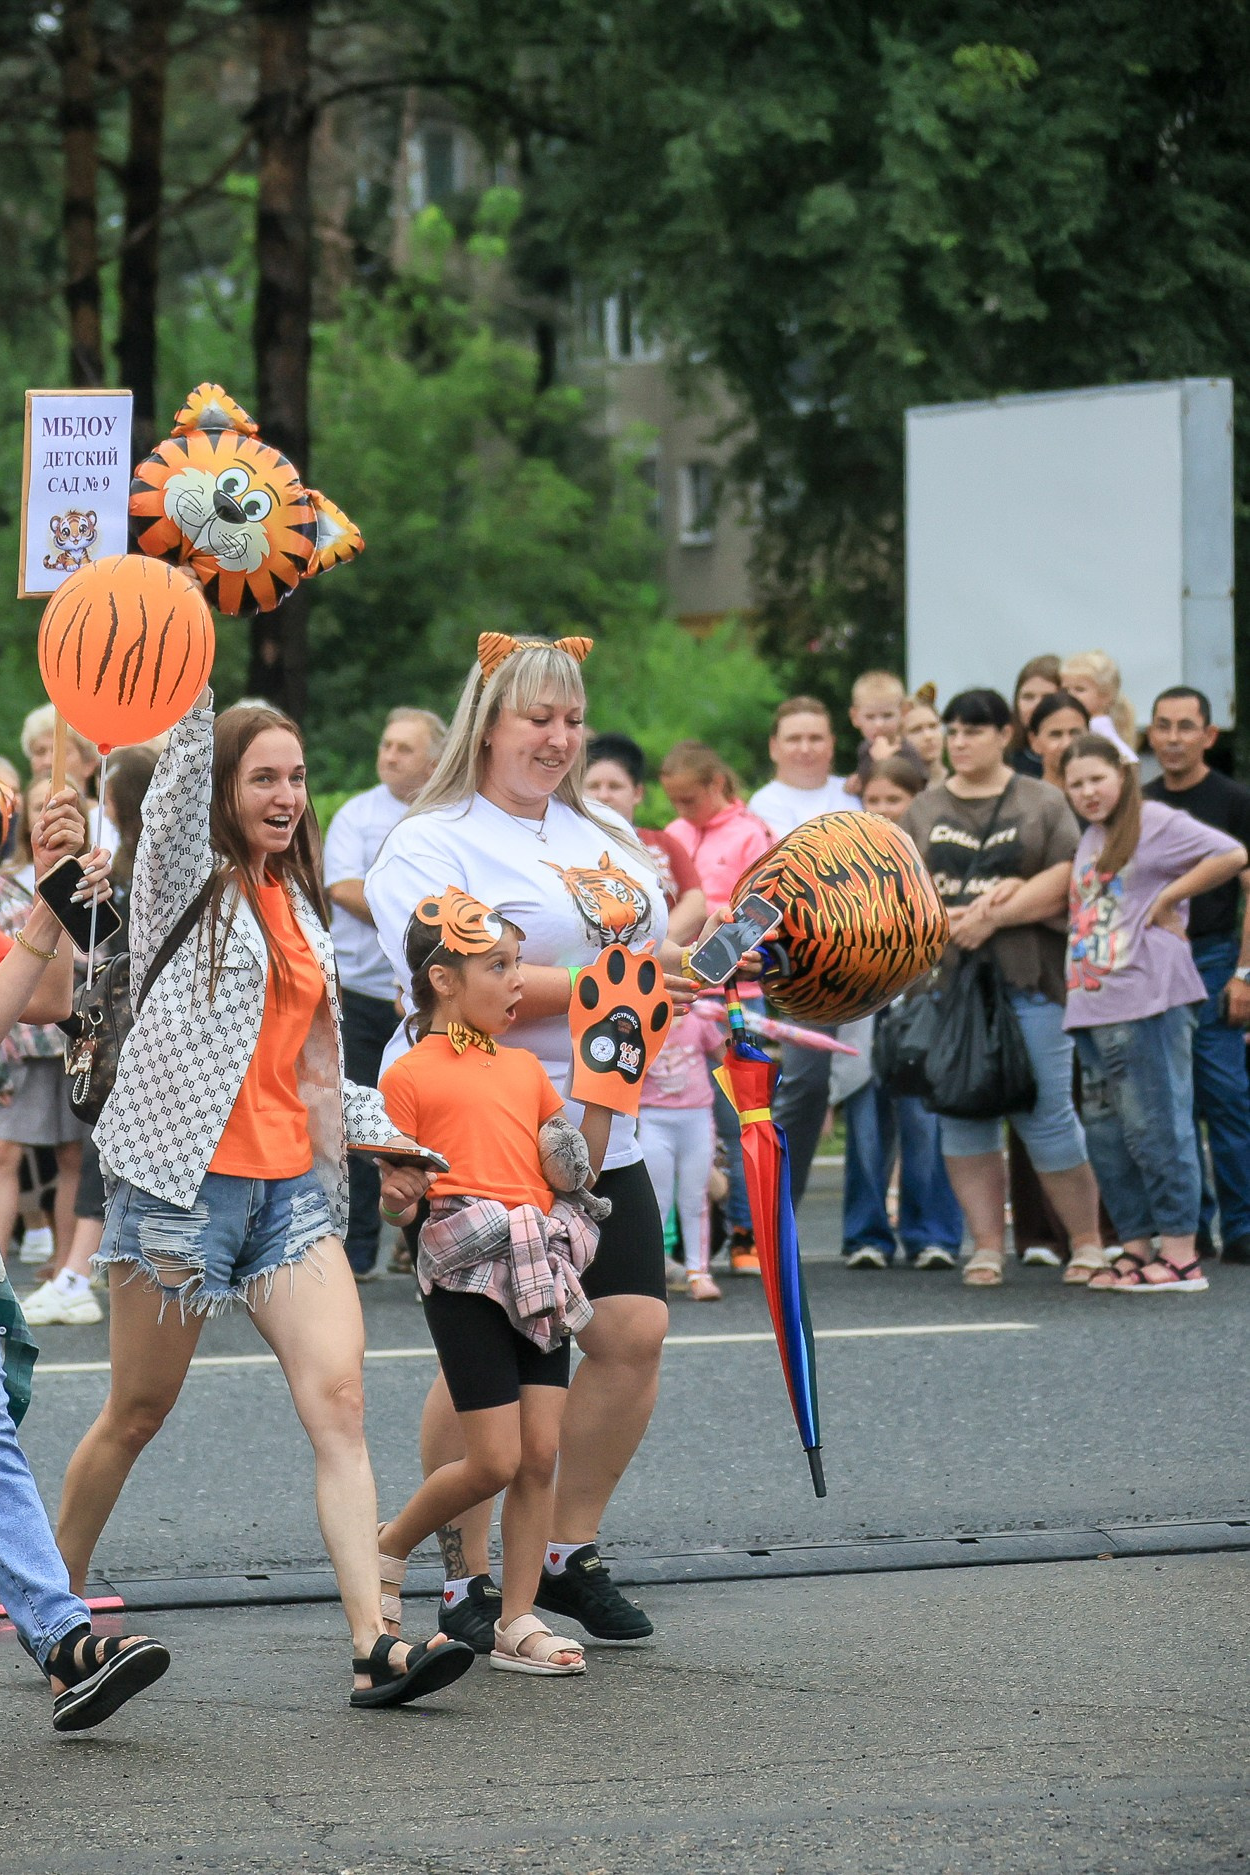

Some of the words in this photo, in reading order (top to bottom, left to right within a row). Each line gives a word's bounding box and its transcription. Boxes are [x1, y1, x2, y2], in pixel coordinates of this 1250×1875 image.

[42, 416, 117, 440] МБДОУ
[43, 447, 118, 469] ДЕТСКИЙ
[48, 477, 80, 495] САД
[83, 477, 98, 492] №
[103, 476, 109, 491] 9
[195, 1014, 206, 1024] GD
[210, 1010, 221, 1020] GD
[162, 1016, 172, 1026] GD
[245, 1016, 255, 1026] GD
[139, 1027, 149, 1037] GD
[215, 1025, 226, 1034] GD
[231, 1022, 242, 1032] GD
[166, 1032, 177, 1042] GD
[143, 1043, 152, 1053] GD
[186, 1042, 198, 1051] GD
[237, 1038, 248, 1048] GD
[129, 1048, 140, 1058] GD
[171, 1048, 182, 1057] GD
[222, 1044, 234, 1054] GD
[158, 1053, 168, 1063] GD
[208, 1050, 219, 1060] GD
[147, 1059, 156, 1069] GD
[192, 1057, 204, 1066] GD
[228, 1060, 239, 1069] GD
[134, 1064, 144, 1074] GD
[177, 1063, 188, 1073] GD
[214, 1066, 225, 1076] GD
[119, 1069, 130, 1079] GD
[163, 1069, 173, 1079] GD
[198, 1072, 210, 1082] GD
[151, 1075, 160, 1084] GD
[183, 1079, 194, 1088] GD
[124, 1085, 134, 1095] GD
[138, 1080, 148, 1090] GD
[169, 1085, 179, 1095] GD
[219, 1082, 230, 1091] GD
[156, 1090, 166, 1100] GD
[204, 1088, 216, 1097] GD
[143, 1096, 152, 1106] GD
[189, 1094, 201, 1104] GD
[129, 1101, 140, 1111] GD
[175, 1100, 185, 1110] GD
[210, 1104, 222, 1113] GD
[115, 1107, 125, 1117] GD
[161, 1106, 171, 1116] GD
[195, 1110, 207, 1119] GD
[134, 1117, 145, 1127] GD
[148, 1112, 157, 1122] GD
[180, 1116, 191, 1125] GD
[119, 1123, 130, 1133] GD
[166, 1122, 177, 1131] GD
[201, 1125, 212, 1134] GD
[153, 1128, 163, 1137] GD
[186, 1131, 197, 1140] GD
[139, 1133, 150, 1143] GD
[172, 1137, 182, 1147] GD
[124, 1139, 135, 1148] GD
[157, 1143, 168, 1153] GD
[144, 1149, 154, 1159] GD
[192, 1146, 203, 1156] GD
[129, 1154, 140, 1164] GD
[177, 1153, 189, 1162] GD
[115, 1160, 125, 1169] GD
[162, 1159, 173, 1168] GD
[149, 1165, 159, 1174] GD
[183, 1168, 194, 1177] GD
[134, 1170, 145, 1180] GD
[169, 1174, 180, 1184] GD
[154, 1180, 165, 1190] GD
[175, 1189, 186, 1199] GD
